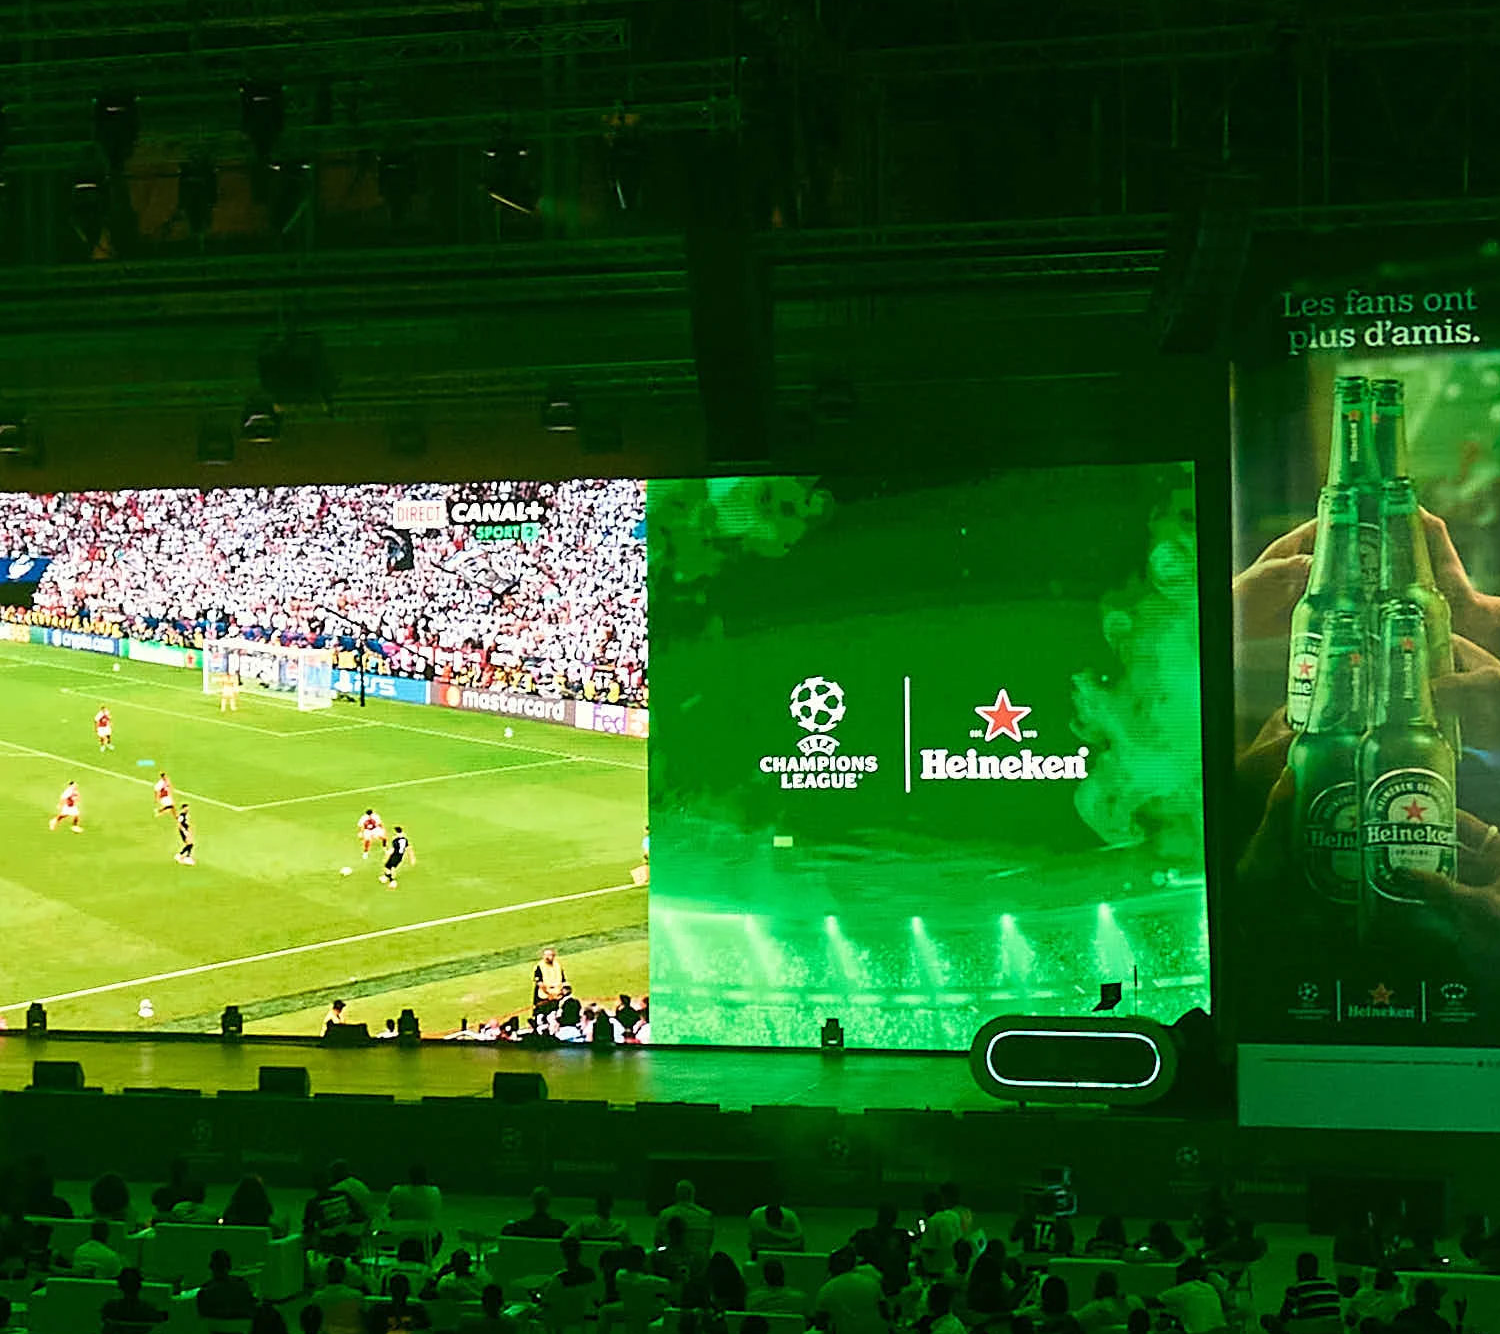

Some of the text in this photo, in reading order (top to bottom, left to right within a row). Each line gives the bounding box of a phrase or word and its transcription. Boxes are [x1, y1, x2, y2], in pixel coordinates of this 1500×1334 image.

[1281, 287, 1479, 317] Les fans ont
[1288, 319, 1480, 355] plus d'amis.
[396, 505, 441, 523] DIRECT
[451, 500, 545, 523] CANAL+
[475, 525, 519, 540] SPORT
[462, 686, 566, 720] mastercard
[759, 755, 878, 773] CHAMPIONS
[920, 748, 1089, 780] Heineken
[781, 772, 858, 789] LEAGUE
